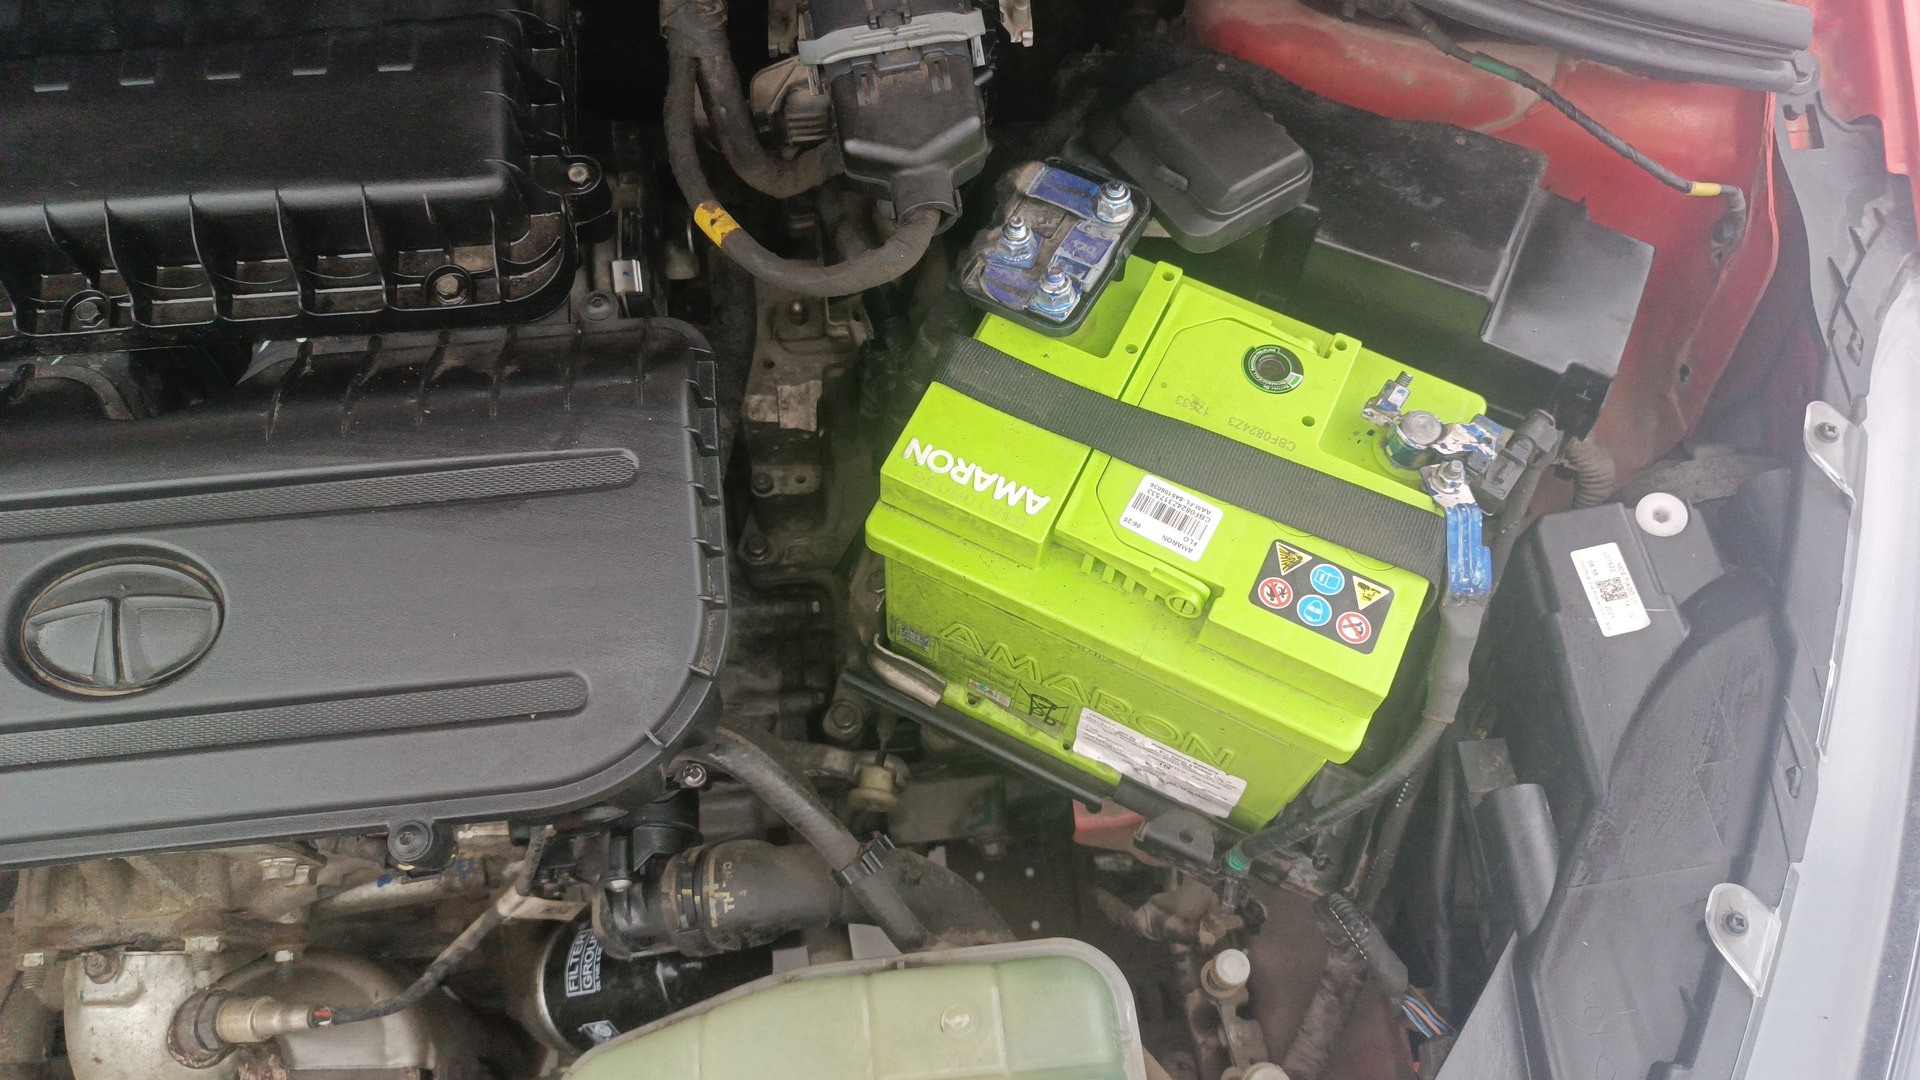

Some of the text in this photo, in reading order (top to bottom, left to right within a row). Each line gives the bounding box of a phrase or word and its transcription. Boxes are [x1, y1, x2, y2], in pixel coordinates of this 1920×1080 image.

[902, 437, 1051, 515] AMARON
[1161, 534, 1194, 554] AMARON
[1183, 536, 1198, 547] FLO
[939, 622, 1237, 774] AMARON
[568, 933, 588, 992] FILTER
[582, 935, 598, 989] GROU
